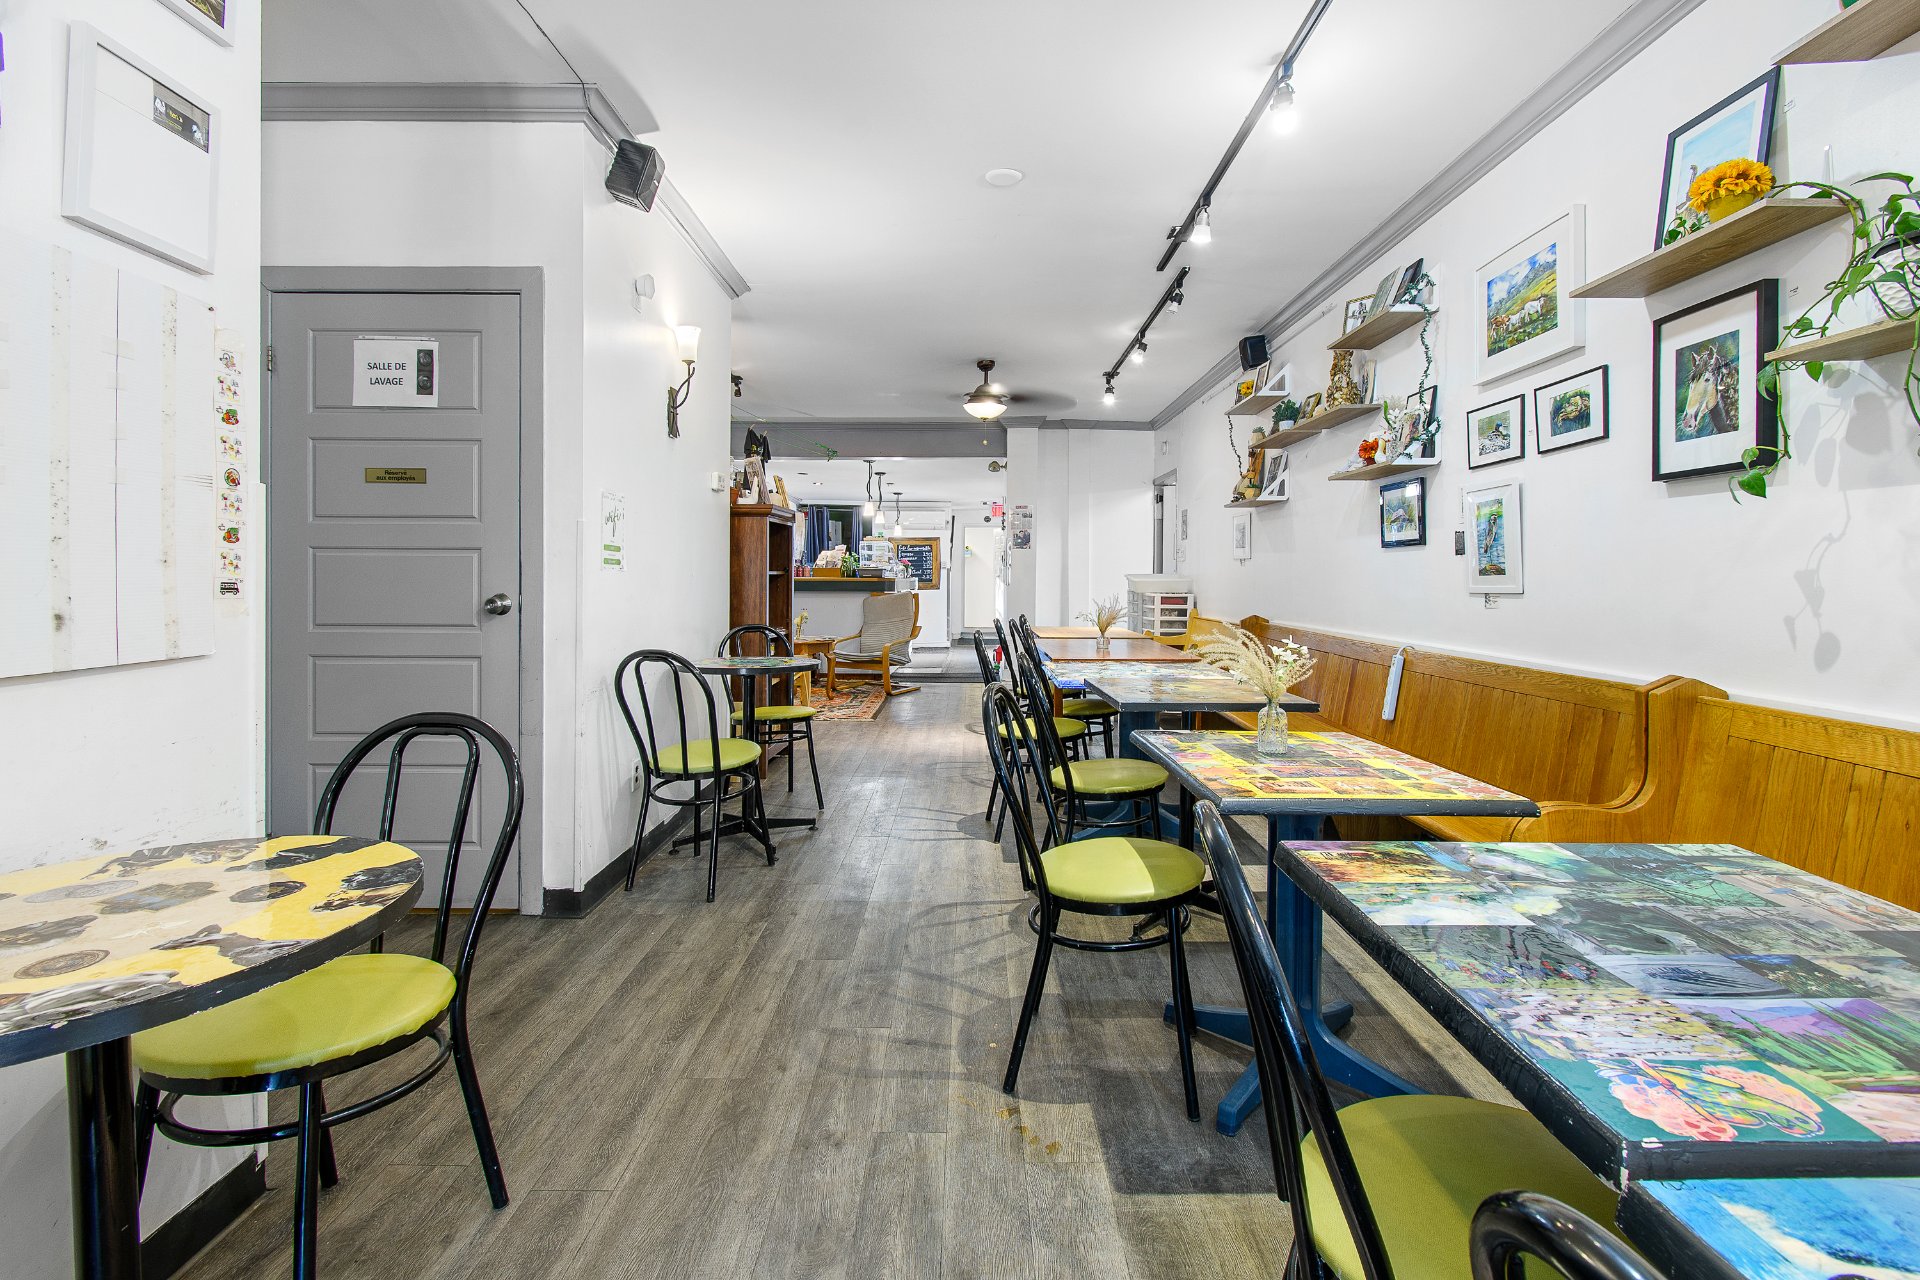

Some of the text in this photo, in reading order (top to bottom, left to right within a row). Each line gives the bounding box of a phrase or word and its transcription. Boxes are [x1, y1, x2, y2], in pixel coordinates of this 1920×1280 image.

[367, 362, 407, 370] SALLE DE
[370, 377, 404, 386] LAVAGE
[388, 474, 416, 482] employés
